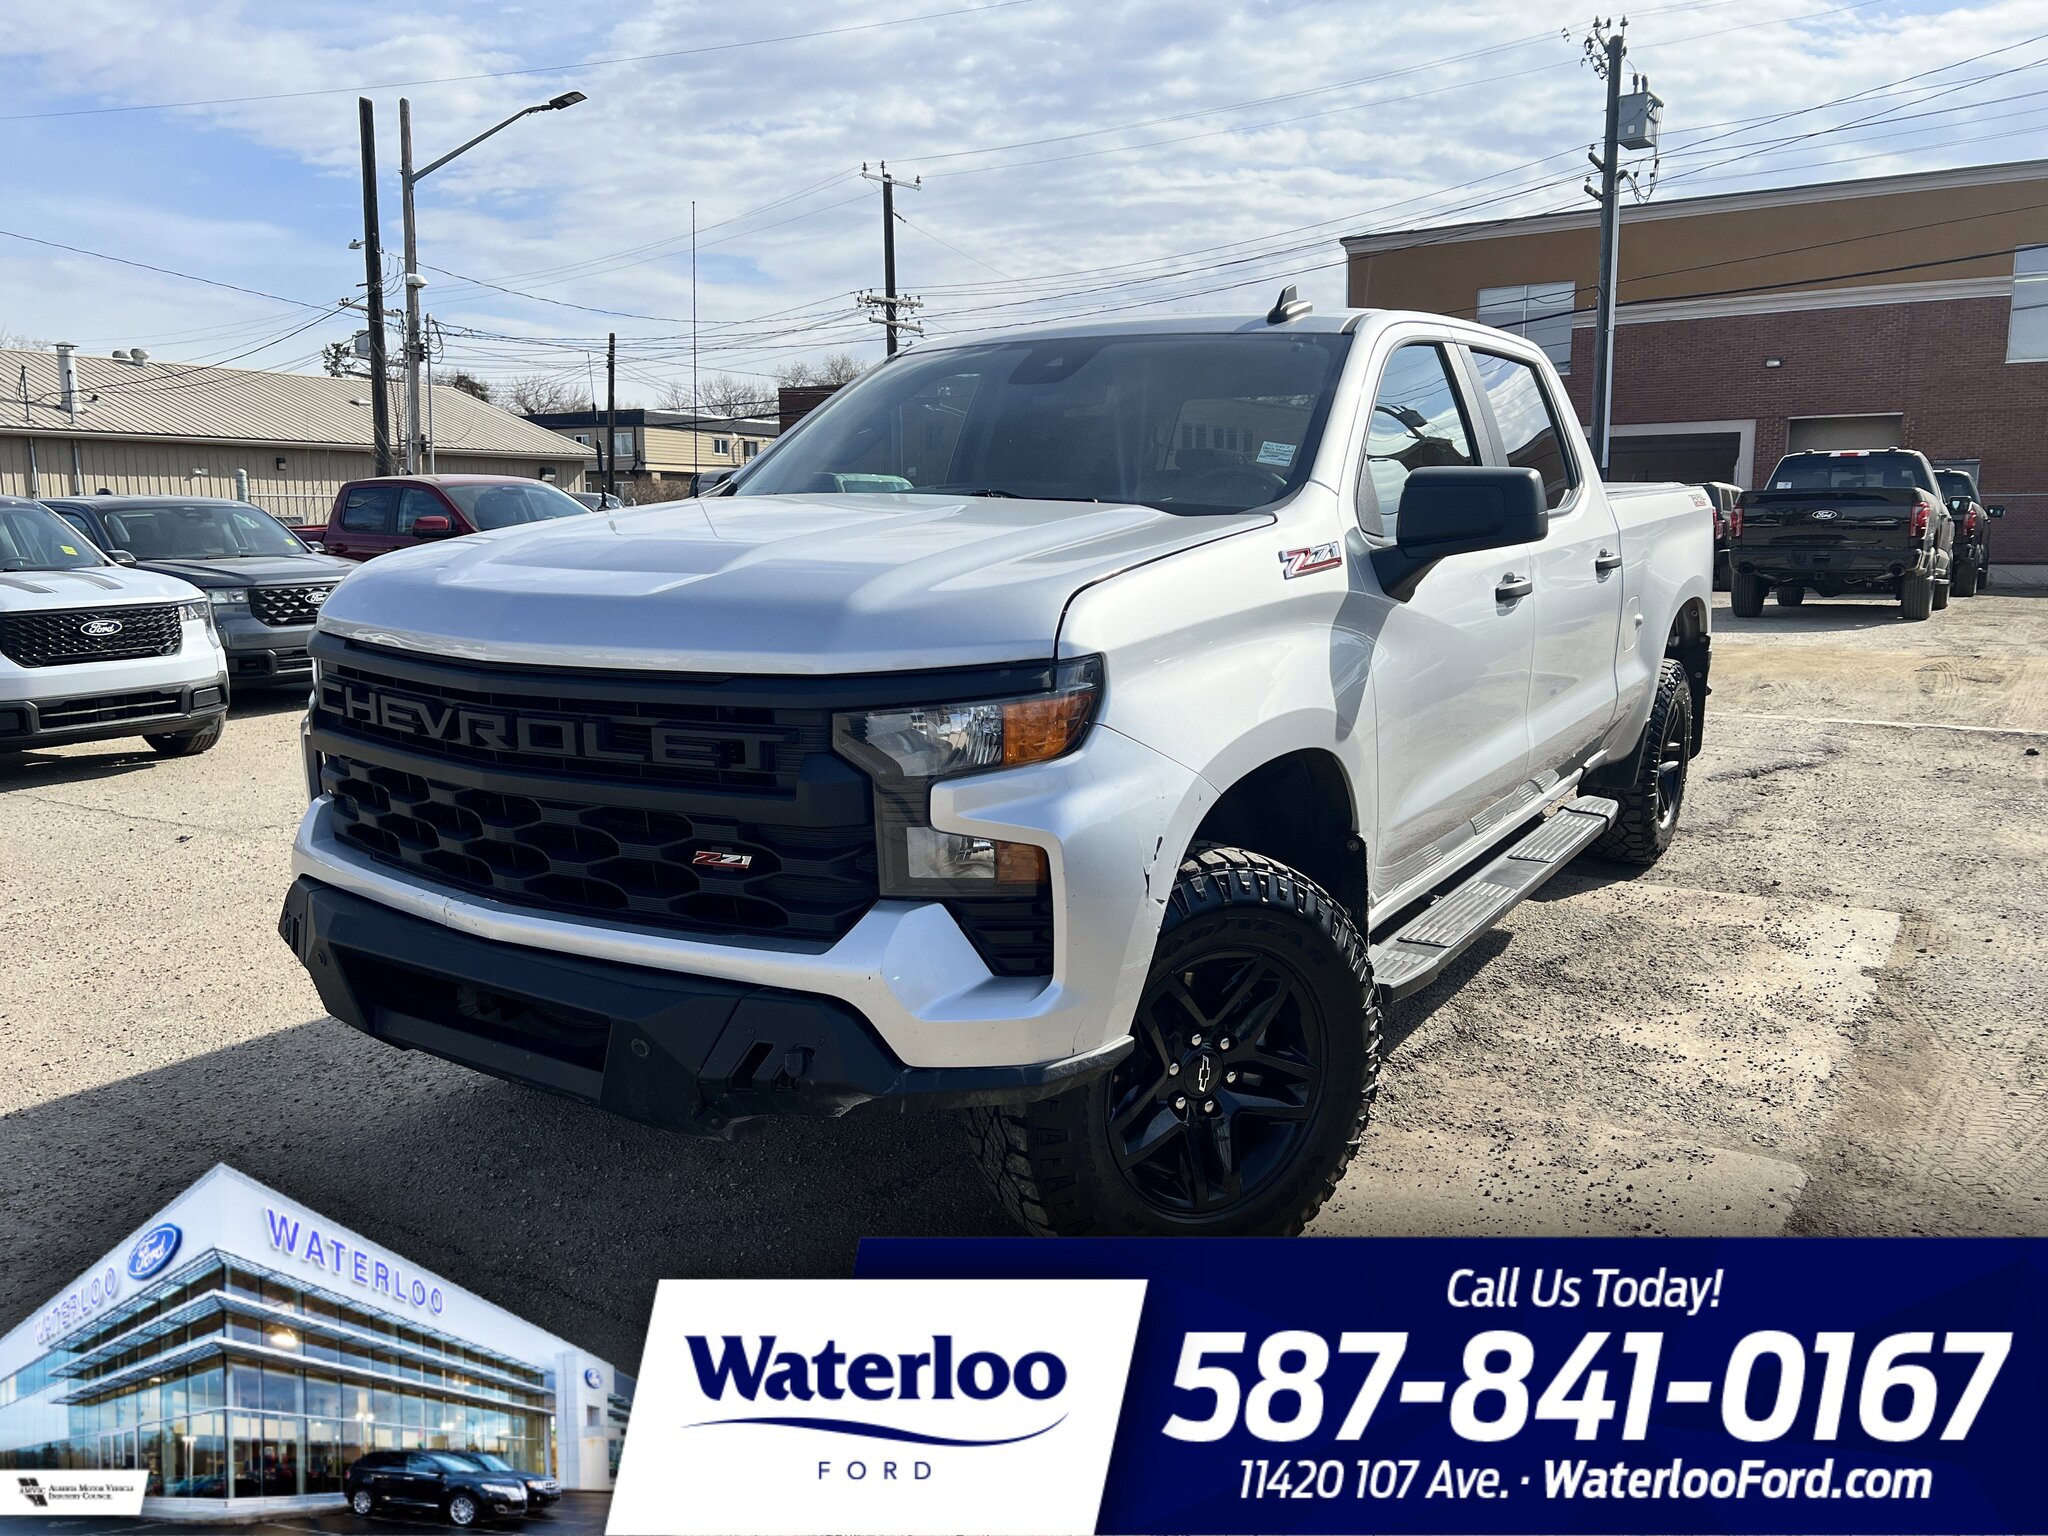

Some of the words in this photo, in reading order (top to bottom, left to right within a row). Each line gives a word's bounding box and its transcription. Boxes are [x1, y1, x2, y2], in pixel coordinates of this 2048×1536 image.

[1278, 541, 1342, 580] Z71
[87, 621, 116, 634] Ford
[317, 677, 797, 771] CHEVROLET
[692, 851, 752, 868] Z71
